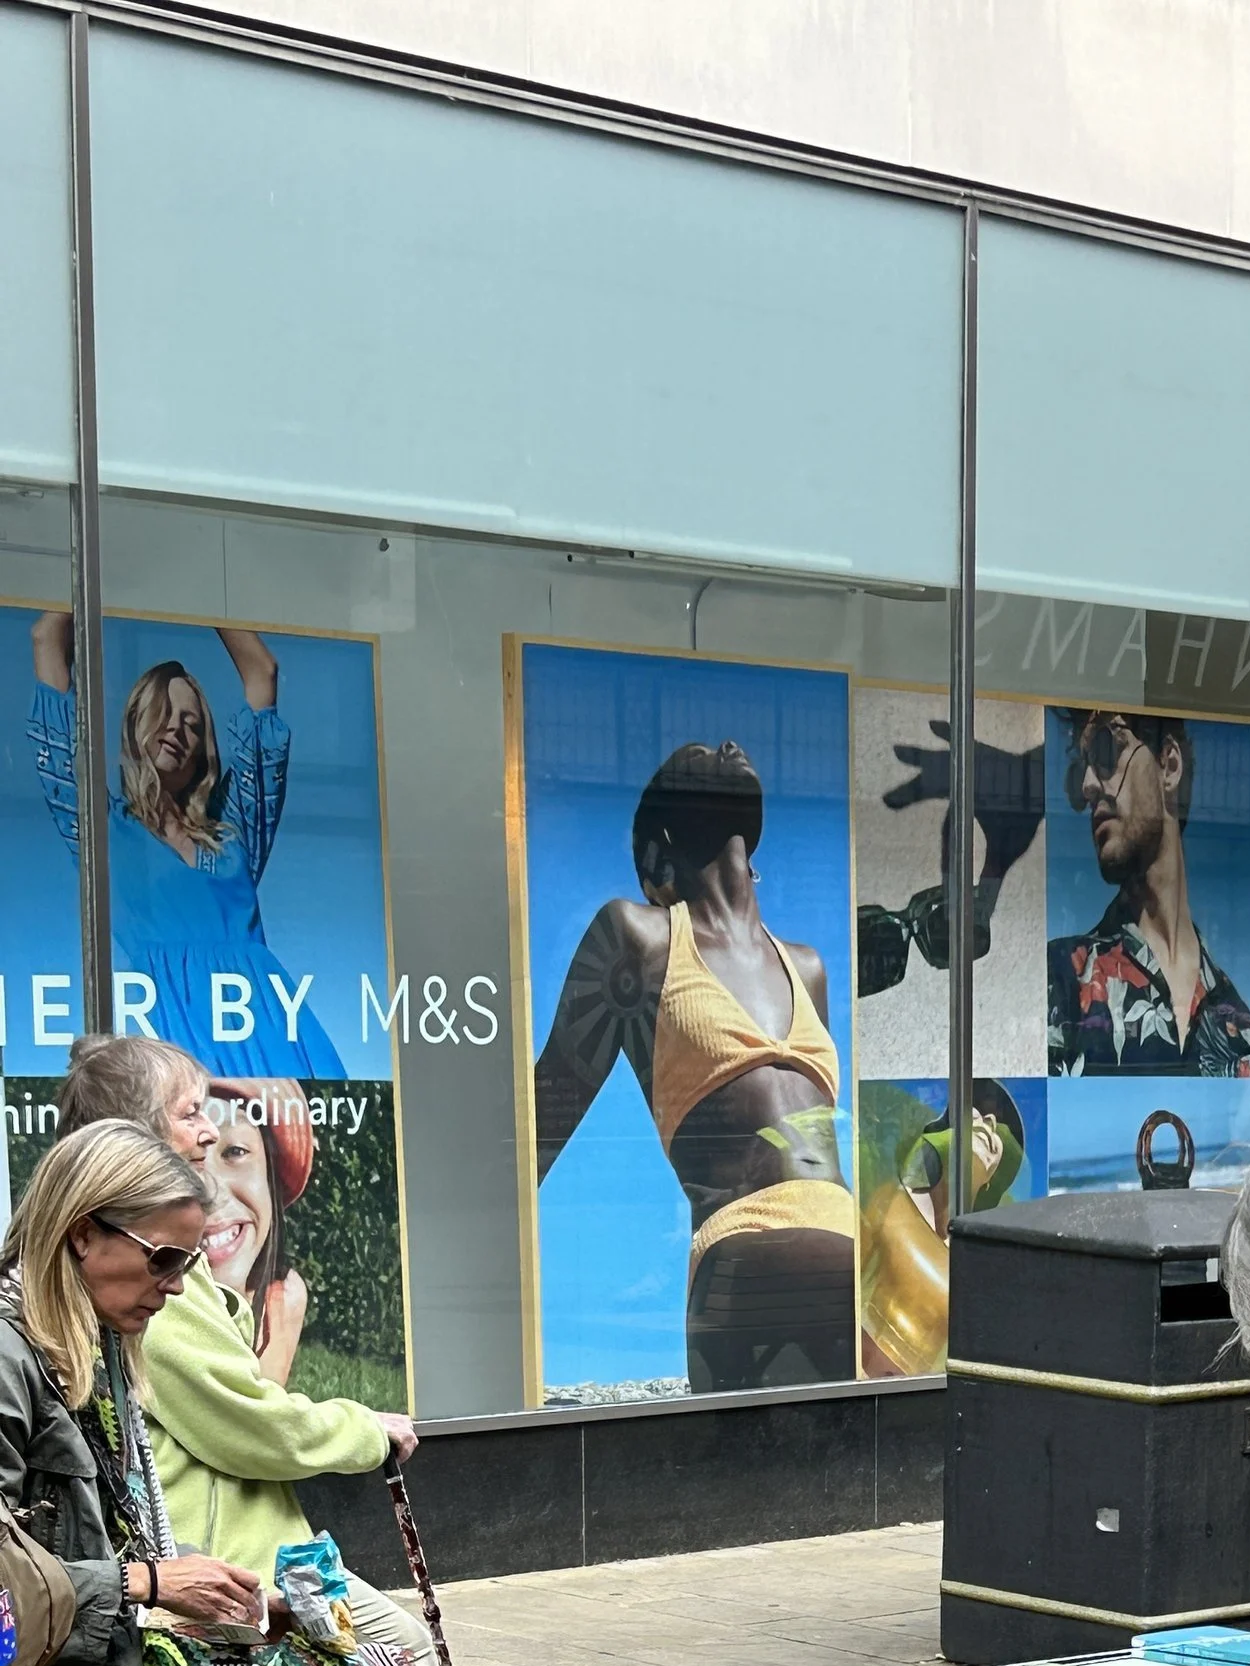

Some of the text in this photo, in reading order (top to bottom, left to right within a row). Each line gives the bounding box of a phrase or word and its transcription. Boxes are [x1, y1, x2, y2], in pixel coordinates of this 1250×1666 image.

[0, 972, 499, 1046] ER BY M&S
